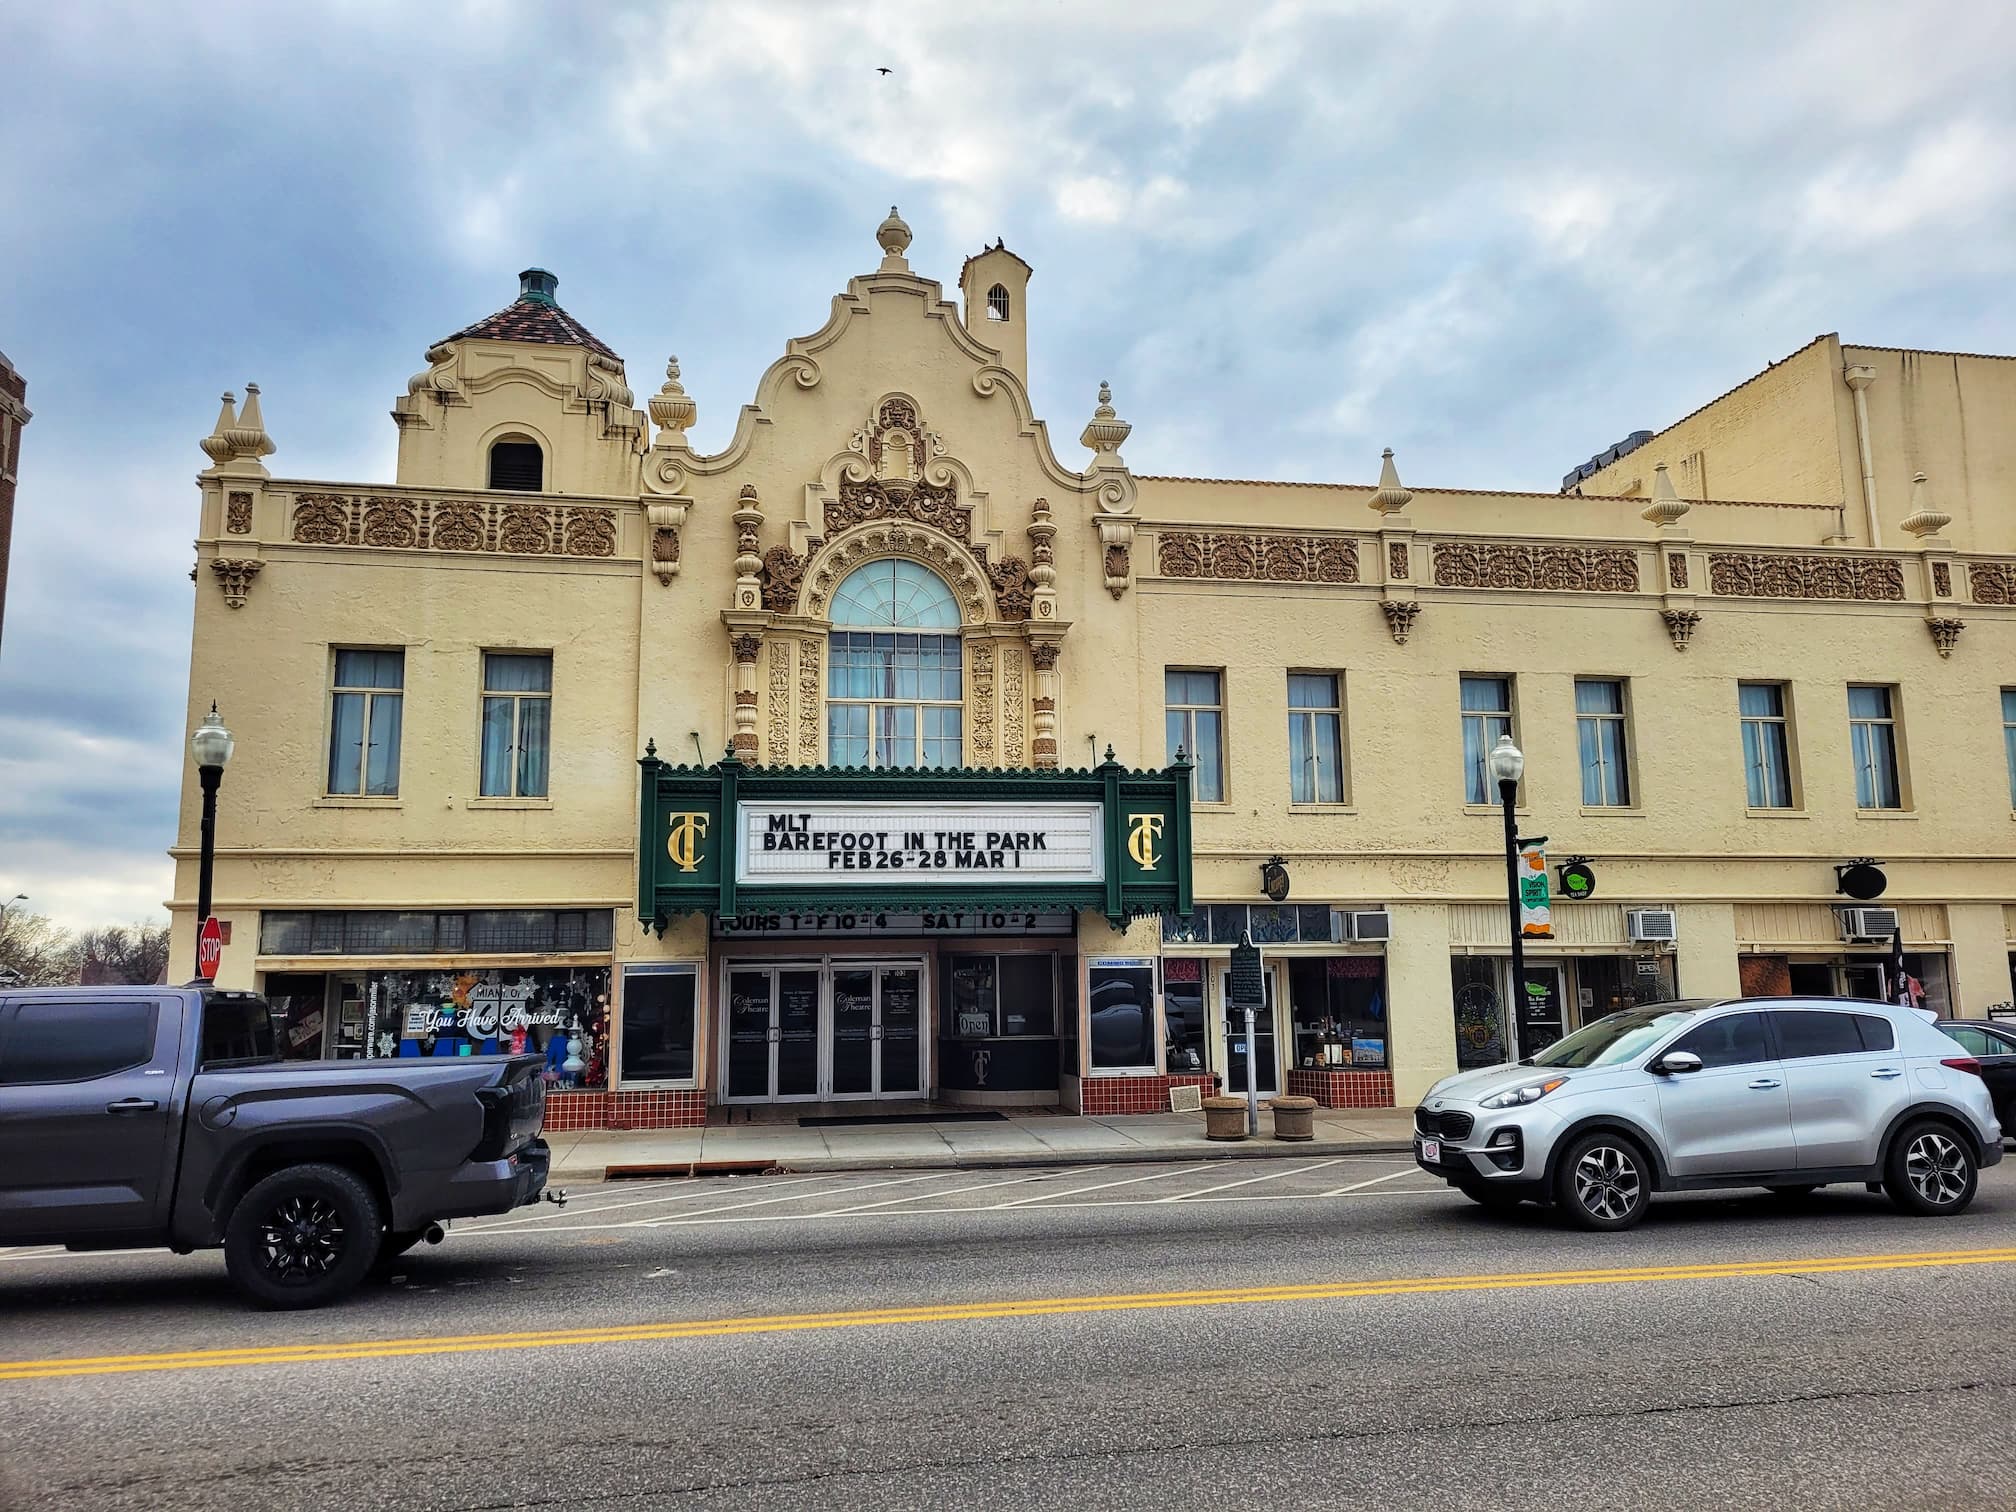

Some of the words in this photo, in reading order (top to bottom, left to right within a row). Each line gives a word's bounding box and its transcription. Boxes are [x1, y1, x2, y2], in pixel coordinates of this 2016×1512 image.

[768, 814, 811, 832] MLT
[763, 832, 888, 851] BAREFOOT
[904, 832, 924, 850] IN
[934, 832, 976, 850] THE
[986, 832, 1047, 850] PARK
[829, 851, 872, 869] FEB
[876, 850, 947, 869] 26-28
[955, 851, 1005, 869] MAR
[923, 913, 965, 929] SAT
[982, 913, 1037, 929] 10-2
[201, 937, 220, 962] STOP
[835, 991, 872, 1006] Coleman
[840, 1001, 872, 1012] Theatre
[419, 1008, 455, 1033] You
[456, 1008, 498, 1028] Have
[500, 1007, 561, 1026] Arrived
[960, 1017, 988, 1034] Open
